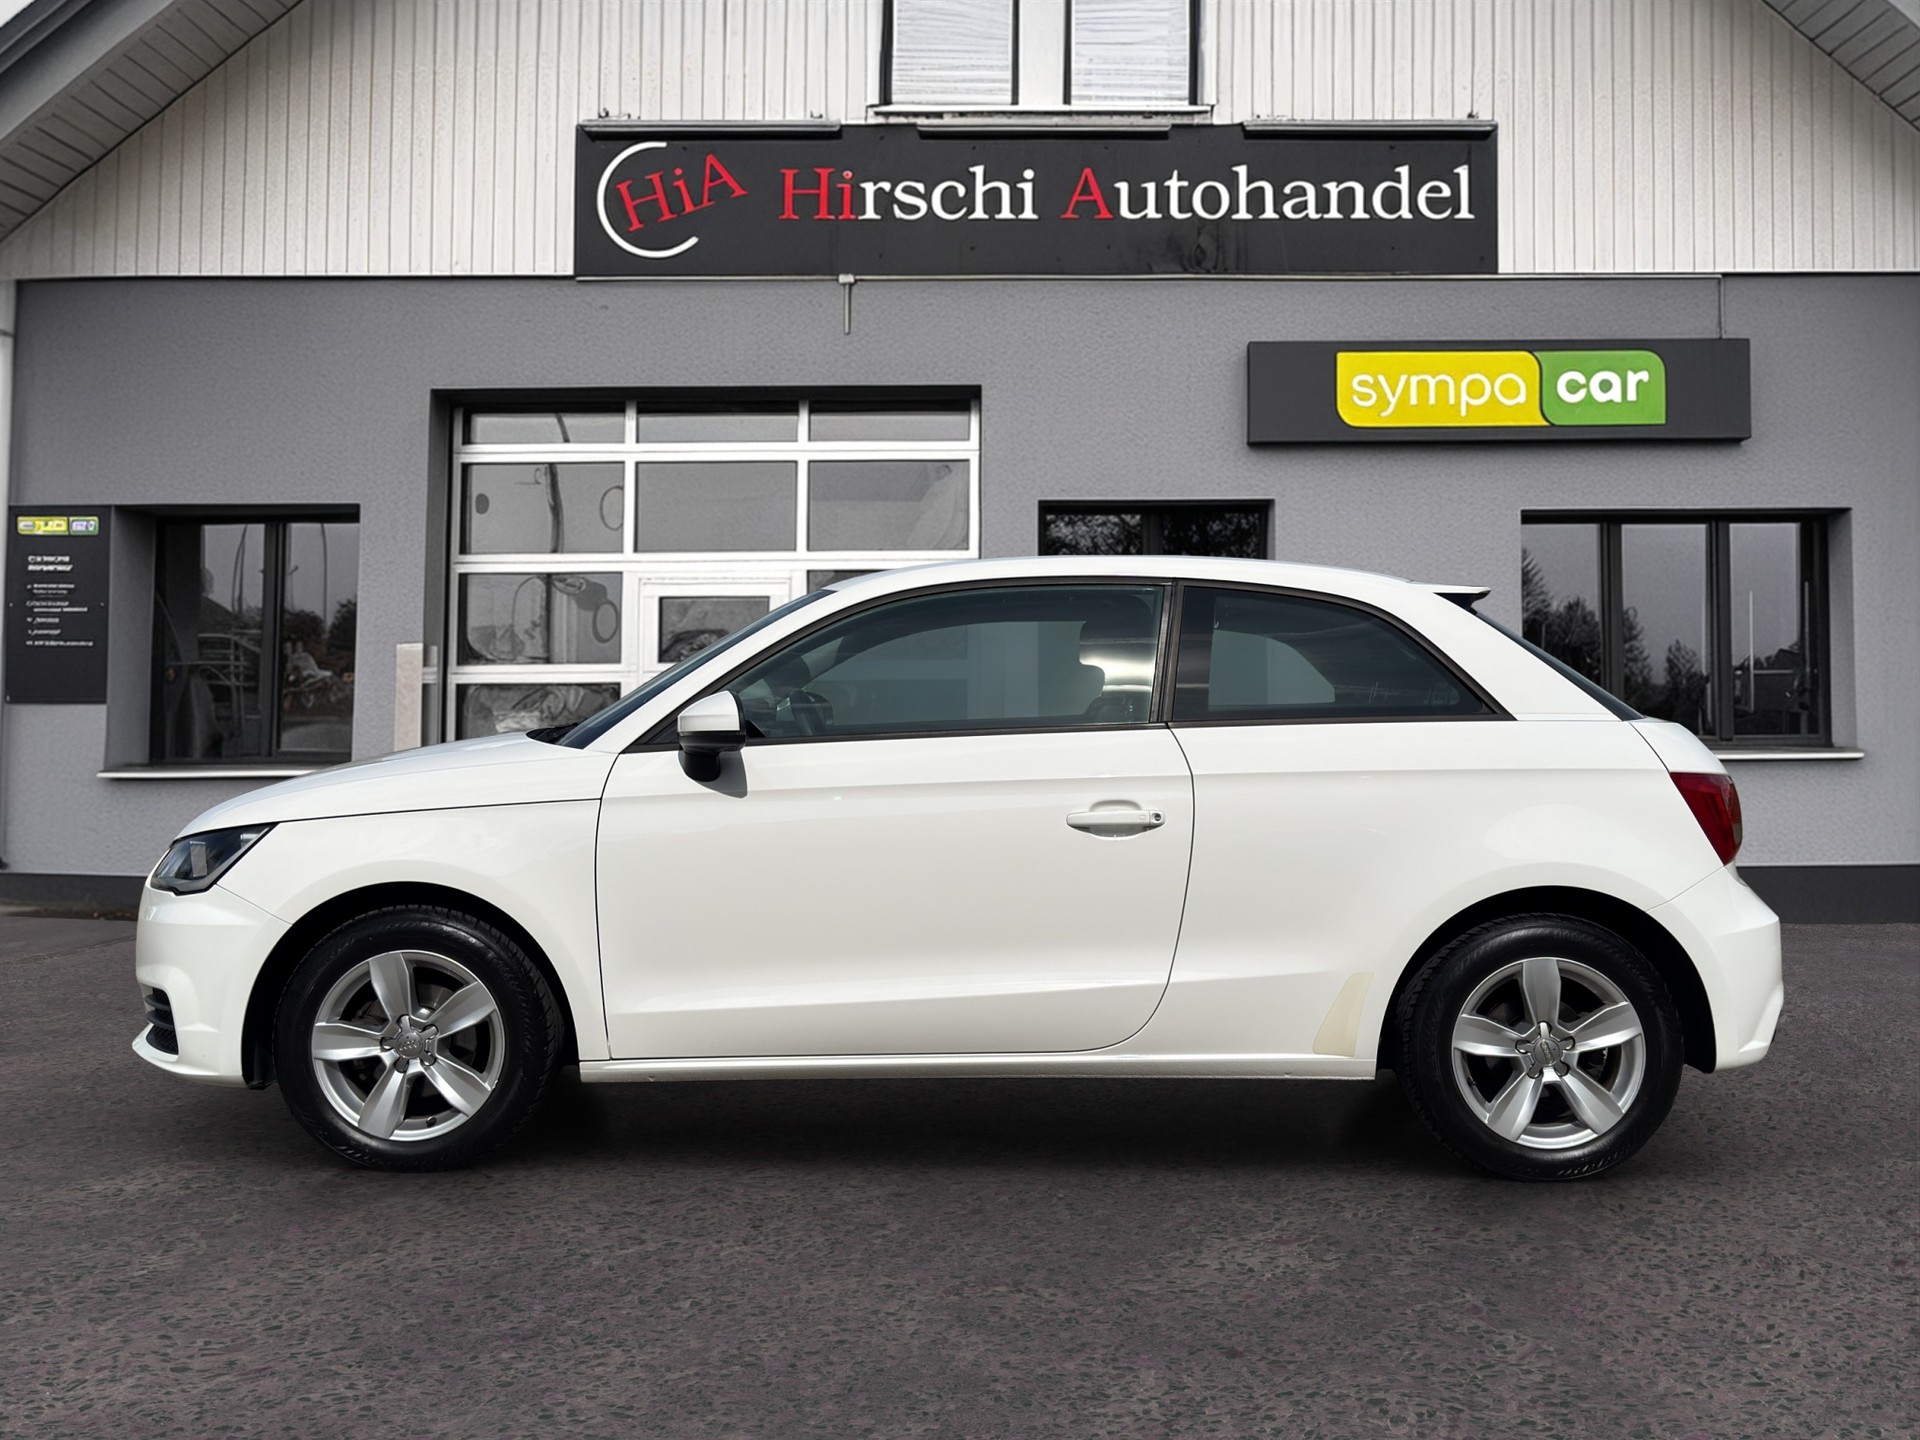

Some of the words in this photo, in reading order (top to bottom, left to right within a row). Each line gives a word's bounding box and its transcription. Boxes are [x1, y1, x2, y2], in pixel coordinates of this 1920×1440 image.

[616, 153, 748, 231] HiA
[779, 165, 1038, 220] Hirschi
[1061, 165, 1475, 220] Autohandel
[1351, 373, 1527, 417] sympa
[1556, 370, 1650, 403] car
